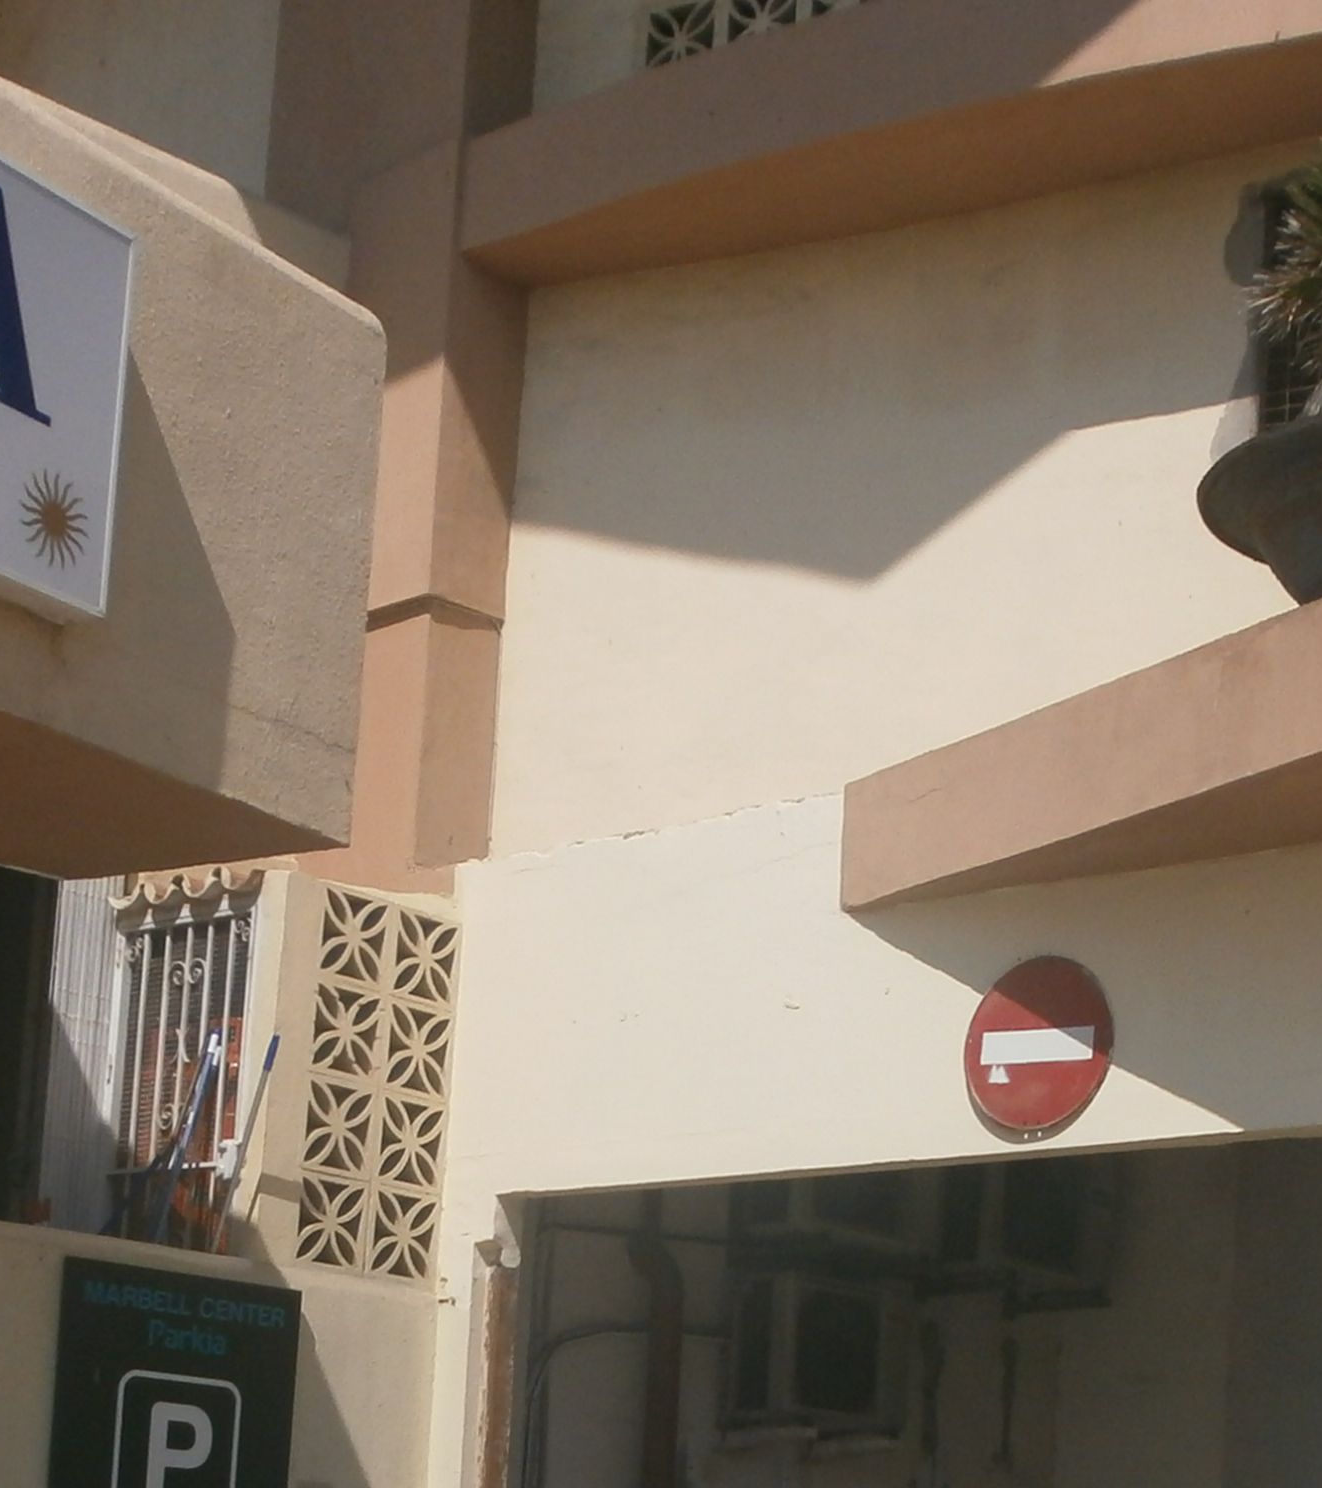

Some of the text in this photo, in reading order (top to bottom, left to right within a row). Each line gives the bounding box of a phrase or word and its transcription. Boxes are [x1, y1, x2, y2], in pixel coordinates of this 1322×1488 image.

[82, 1281, 286, 1328] MARBELL CENTER
[148, 1318, 227, 1356] Parkia
